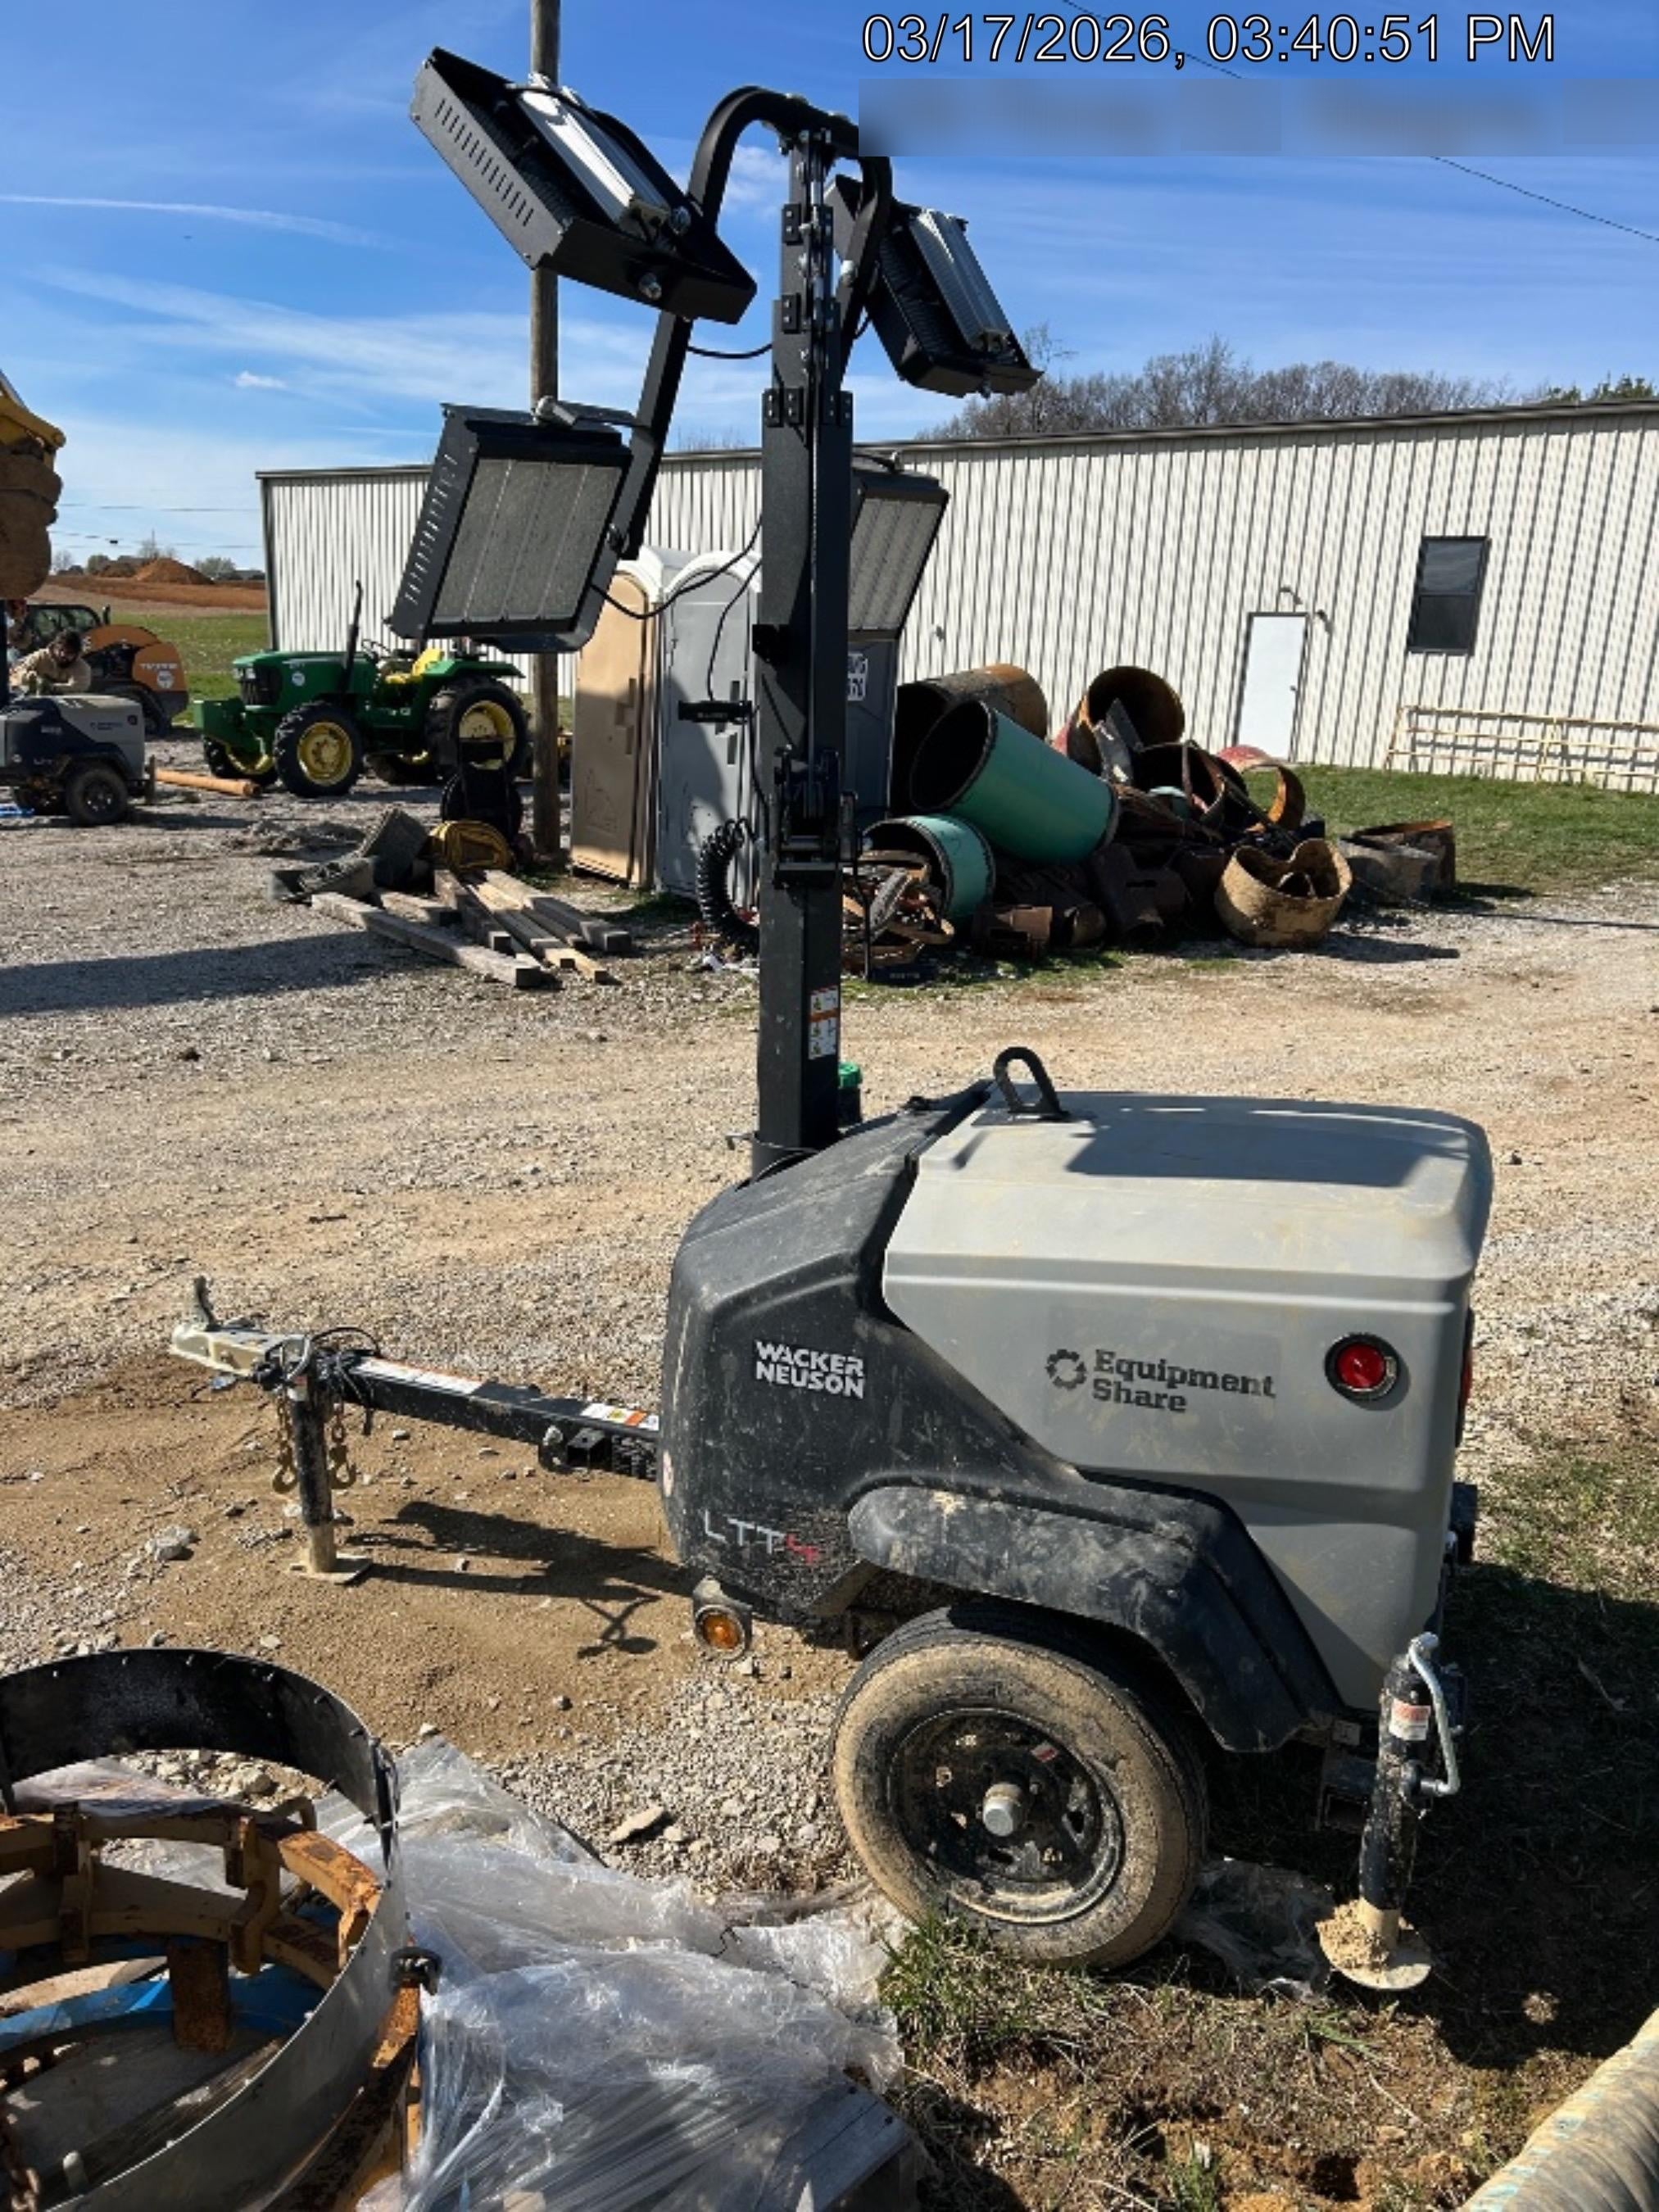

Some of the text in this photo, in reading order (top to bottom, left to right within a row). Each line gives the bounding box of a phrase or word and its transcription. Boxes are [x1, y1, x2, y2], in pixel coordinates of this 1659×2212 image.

[755, 1339, 864, 1377] WACKER
[1093, 1349, 1276, 1398] Equipment
[755, 1360, 864, 1399] NEUSON
[1092, 1378, 1187, 1412] Share
